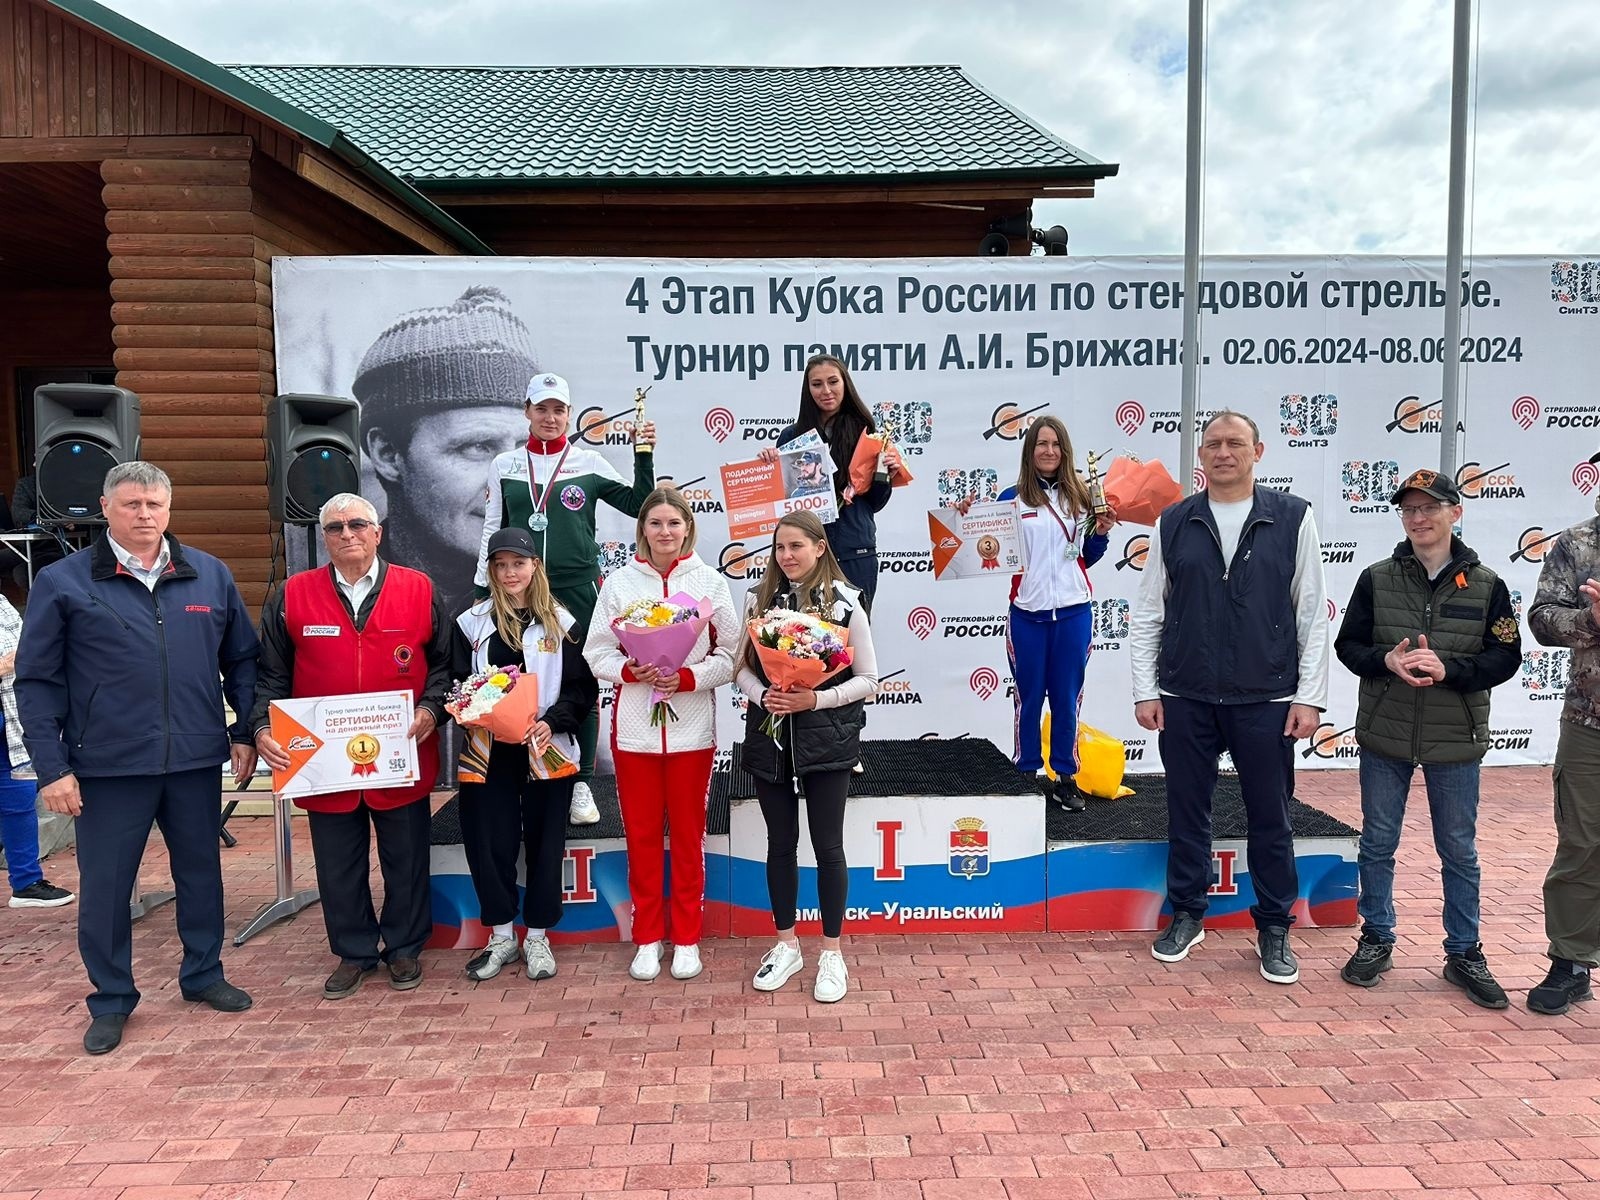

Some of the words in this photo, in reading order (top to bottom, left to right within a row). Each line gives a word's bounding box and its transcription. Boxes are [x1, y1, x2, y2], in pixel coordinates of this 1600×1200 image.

[626, 277, 649, 314] 4
[662, 276, 754, 314] Этап
[769, 275, 884, 322] Кубка
[898, 276, 1036, 313] России
[1050, 282, 1095, 311] по
[1108, 271, 1308, 315] стендовой
[1559, 306, 1599, 314] СинТЗ
[627, 336, 769, 380] Турнир
[939, 333, 1013, 370] А.И.
[1223, 336, 1523, 365] 02.06.2024-08.062024
[1280, 393, 1338, 436] 90
[1427, 409, 1443, 420] СС
[1544, 405, 1596, 413] СТРЕЛКОВЫЙ
[613, 420, 634, 432] СС
[739, 417, 795, 426] СТРЕЛКОВЫЙ
[1546, 415, 1600, 428] РОССИ
[742, 427, 781, 441] РОС
[1288, 439, 1329, 448] СинТЗ
[725, 463, 775, 478] ПОДАРОЧНЫЙ
[727, 472, 773, 487] СЕРТИФИКАТ
[1269, 476, 1293, 484] СОЮЗ
[1488, 475, 1515, 486] ССК
[683, 489, 712, 500] ССК
[690, 501, 724, 513] НАРА
[1350, 505, 1390, 514] СинТЗ
[962, 518, 1013, 530] СЕРТИФИКАТ
[985, 541, 992, 551] 3
[754, 555, 771, 567] СС
[1321, 551, 1354, 563] СИИ
[879, 560, 935, 573] РОССИ
[941, 615, 994, 623] СТРЕЛКОВЫЙ
[944, 625, 1007, 637] РОССИ
[883, 681, 911, 692] ССК
[876, 693, 922, 705] ИНАРА
[325, 713, 401, 727] СЕРТИФИКАТ
[338, 724, 381, 733] денежный
[383, 722, 402, 730] приз
[359, 740, 367, 754] 1
[1488, 737, 1530, 750] ССИИ
[874, 819, 905, 881] I
[773, 901, 1004, 924] амск-Уральский
